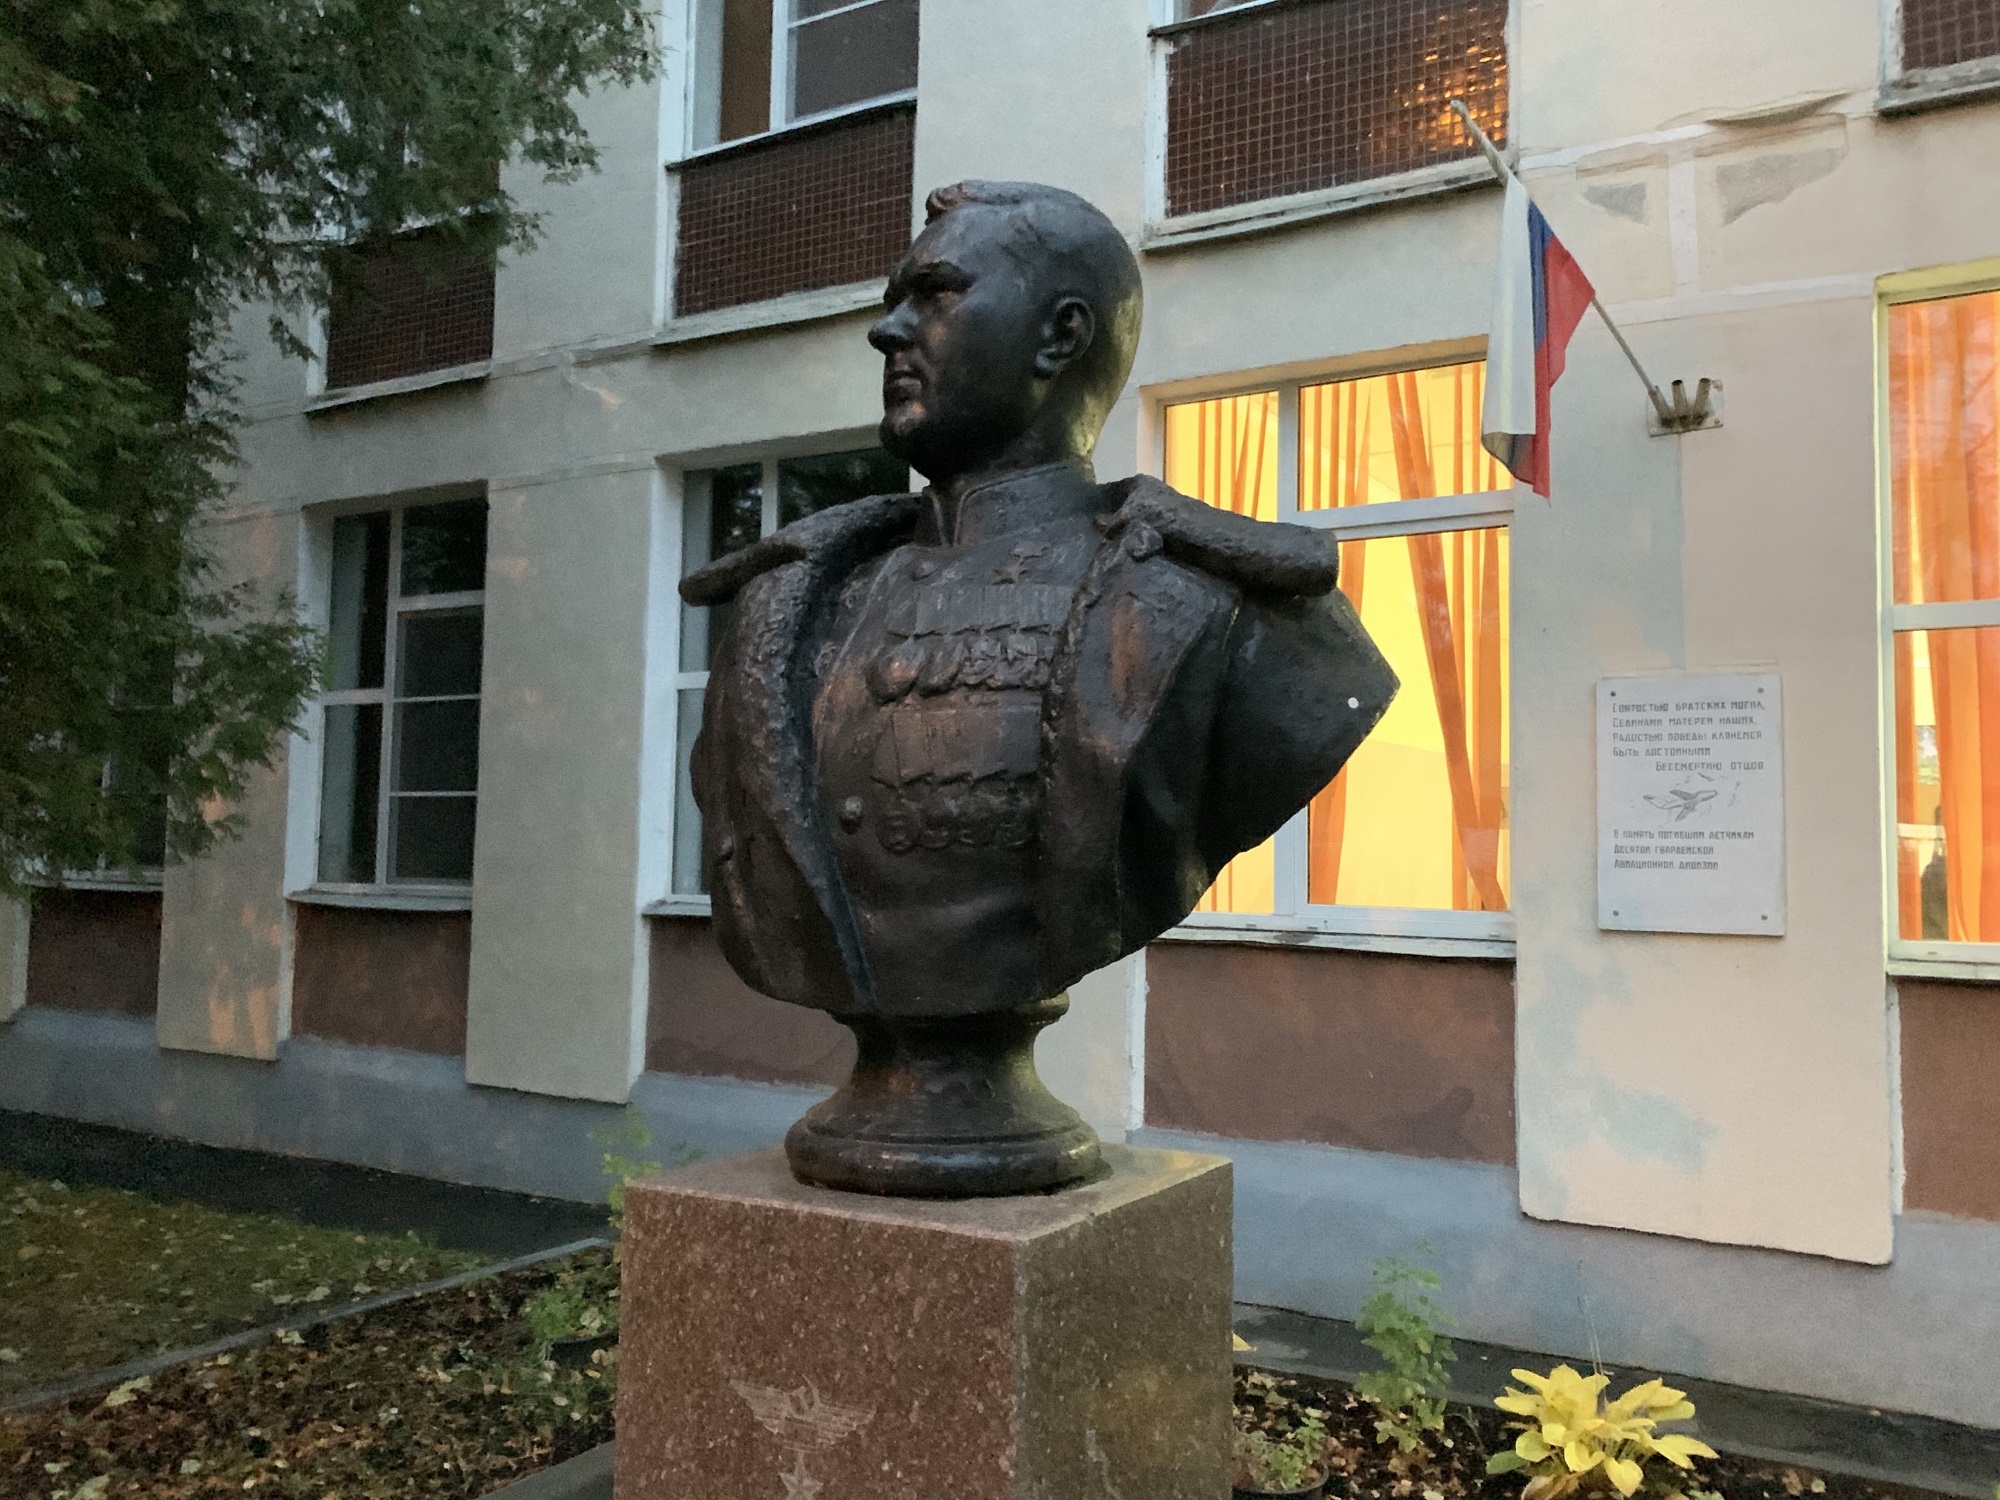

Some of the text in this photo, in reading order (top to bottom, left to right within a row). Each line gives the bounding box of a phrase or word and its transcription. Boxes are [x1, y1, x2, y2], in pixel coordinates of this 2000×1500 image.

[1675, 701, 1726, 711] БРАТСКИХ
[1612, 732, 1663, 742] РАДОСТЬЮ
[1667, 732, 1707, 741] ПОБЕДЫ
[1612, 747, 1639, 757] БЫТЬ
[1656, 761, 1764, 771] БЕССМЕРТИЮ ОТЦОВ
[1613, 829, 1619, 839] В
[1623, 830, 1655, 839] ПАМЯТЬ
